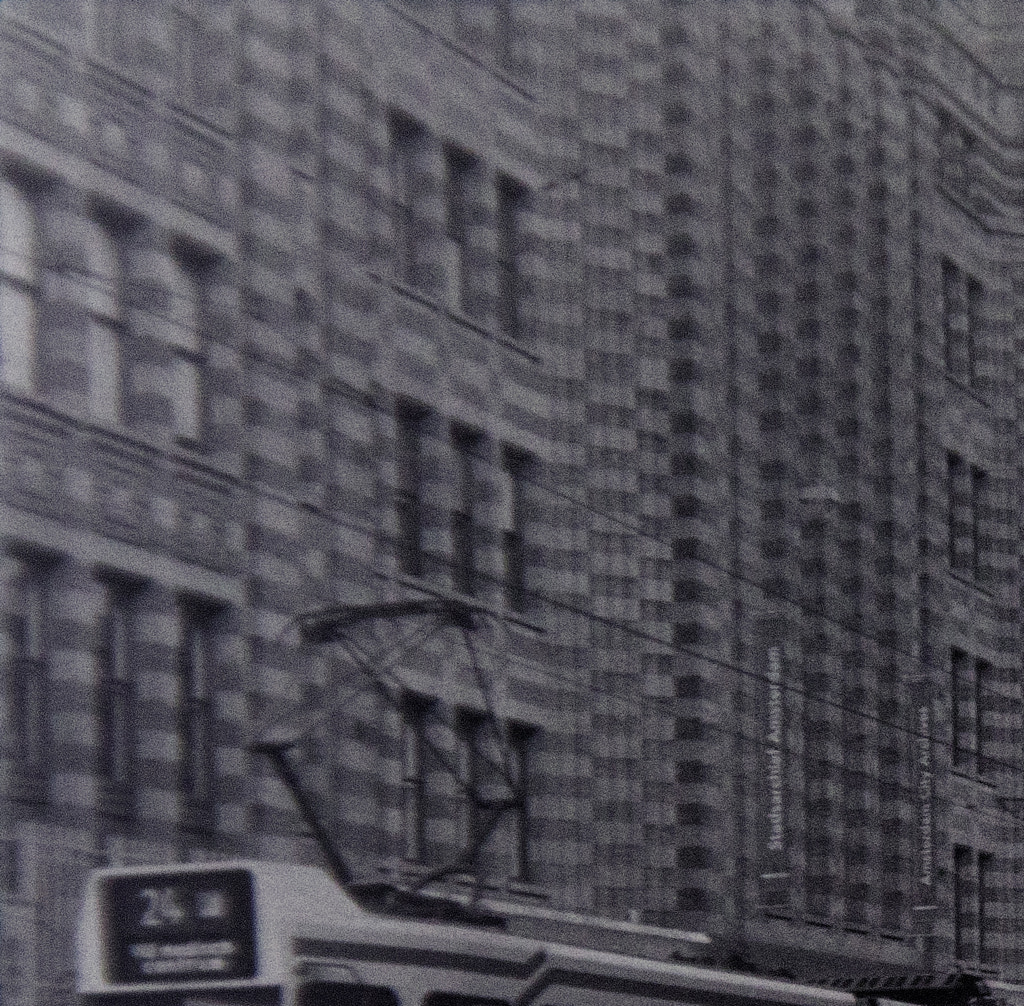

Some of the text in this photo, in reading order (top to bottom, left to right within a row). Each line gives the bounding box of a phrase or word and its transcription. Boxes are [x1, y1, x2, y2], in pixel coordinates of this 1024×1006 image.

[765, 645, 784, 852] Stadsarchief Amsterdam
[918, 770, 934, 801] City
[919, 803, 932, 887] Amsterdam
[138, 887, 185, 928] 24
